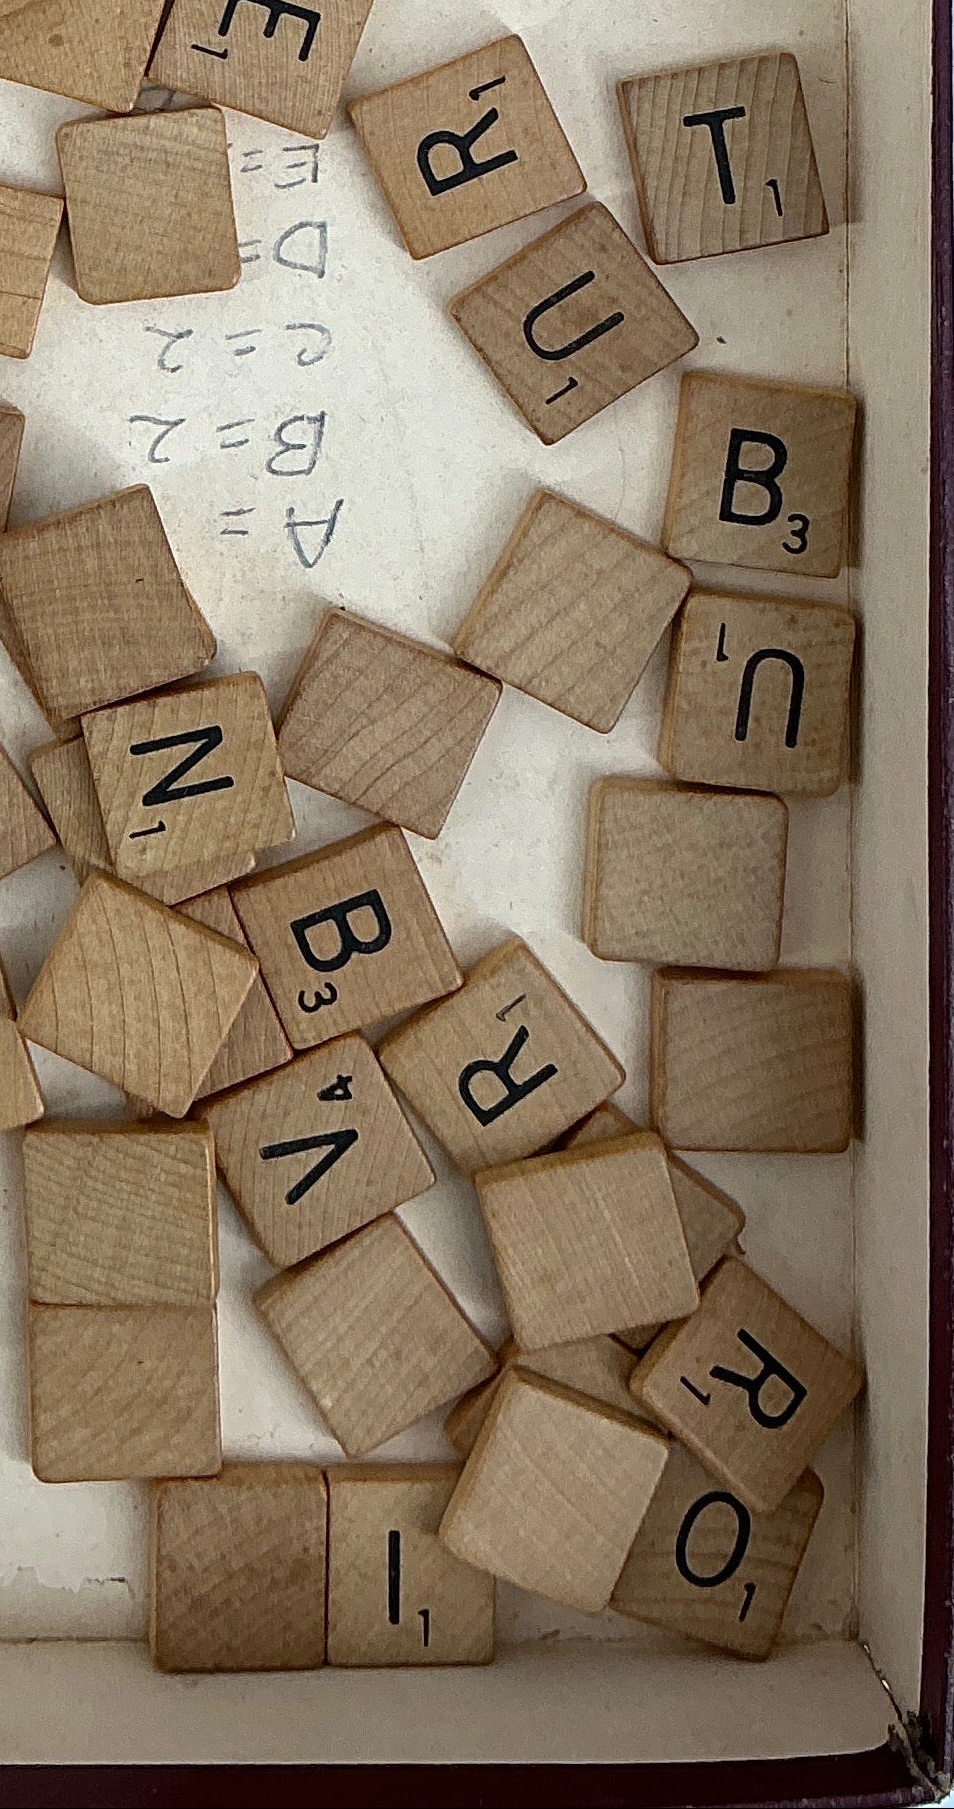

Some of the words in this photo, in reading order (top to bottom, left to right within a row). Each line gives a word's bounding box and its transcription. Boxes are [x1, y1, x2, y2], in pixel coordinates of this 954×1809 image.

[190, 43, 230, 61] 1
[467, 75, 508, 102] 1
[274, 143, 320, 189] E
[415, 106, 520, 198] R
[681, 104, 748, 206] T
[763, 177, 784, 218] 1
[272, 219, 328, 279] D
[145, 325, 194, 373] 2
[522, 269, 626, 362] U
[544, 375, 580, 406] 1
[128, 414, 187, 464] 2
[265, 411, 326, 477] B
[717, 426, 789, 527] B
[780, 512, 812, 556] 3
[283, 497, 345, 569] A
[715, 621, 730, 663] 1
[733, 647, 806, 750] U
[128, 724, 236, 808] N
[127, 819, 167, 840] 1
[288, 887, 393, 974] B
[296, 981, 339, 1014] 3
[494, 994, 527, 1023] 1
[457, 1023, 560, 1129] R
[258, 1127, 360, 1207] V
[315, 1073, 354, 1103] 4
[678, 1374, 713, 1408] 1
[707, 1327, 809, 1431] R
[387, 1529, 402, 1627] I
[416, 1607, 431, 1649] 1
[674, 1488, 752, 1590] O
[737, 1579, 758, 1625] 1
